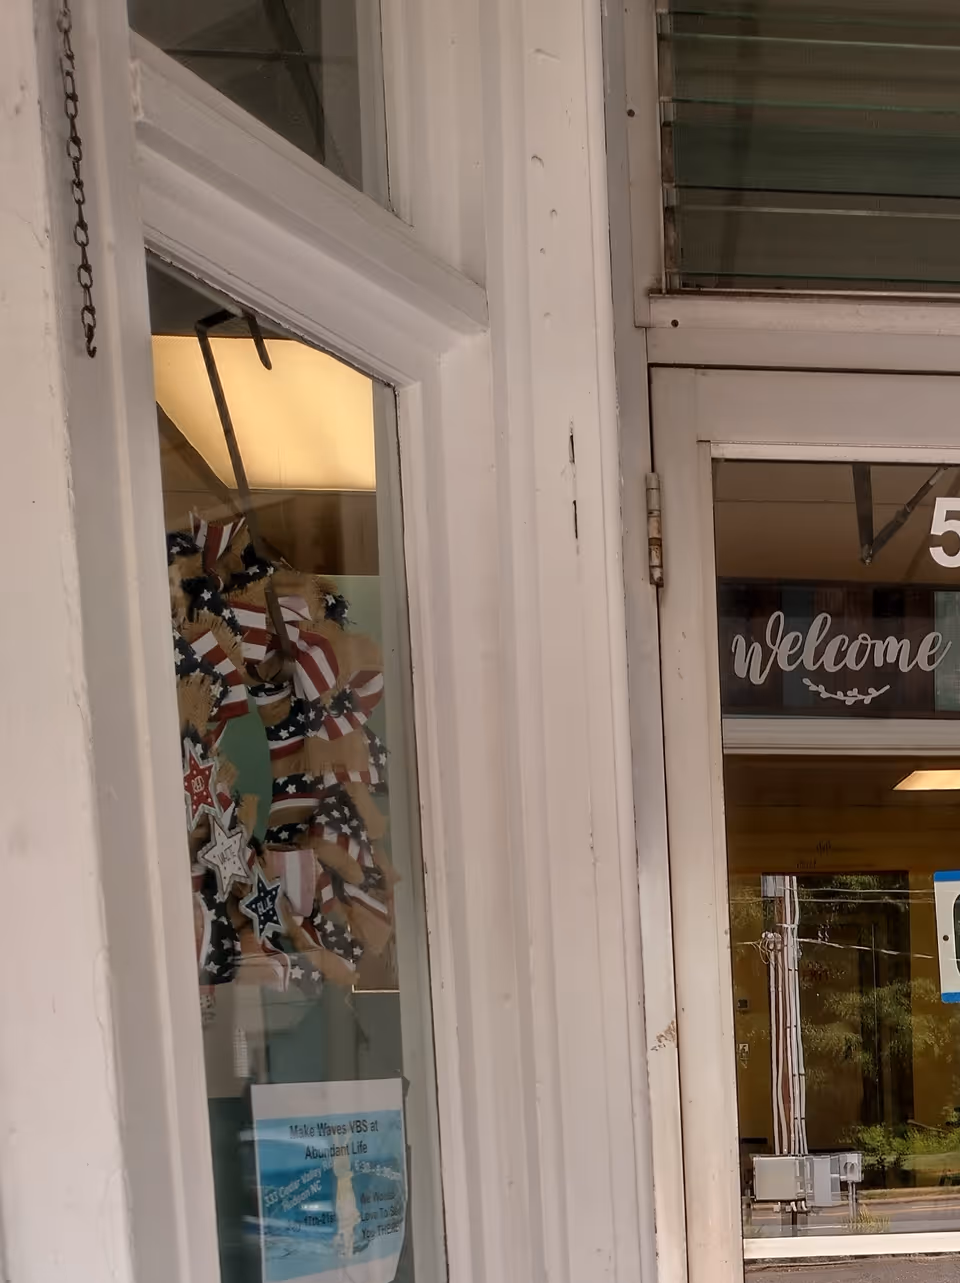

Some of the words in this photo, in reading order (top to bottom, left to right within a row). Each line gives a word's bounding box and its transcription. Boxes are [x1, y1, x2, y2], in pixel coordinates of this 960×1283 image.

[191, 775, 205, 793] RED
[257, 895, 274, 915] BLUE
[289, 1125, 315, 1139] Make
[316, 1122, 347, 1137] Waves
[349, 1120, 368, 1134] VBS
[370, 1120, 379, 1132] at
[305, 1144, 350, 1160] Abundant
[352, 1141, 368, 1154] Life
